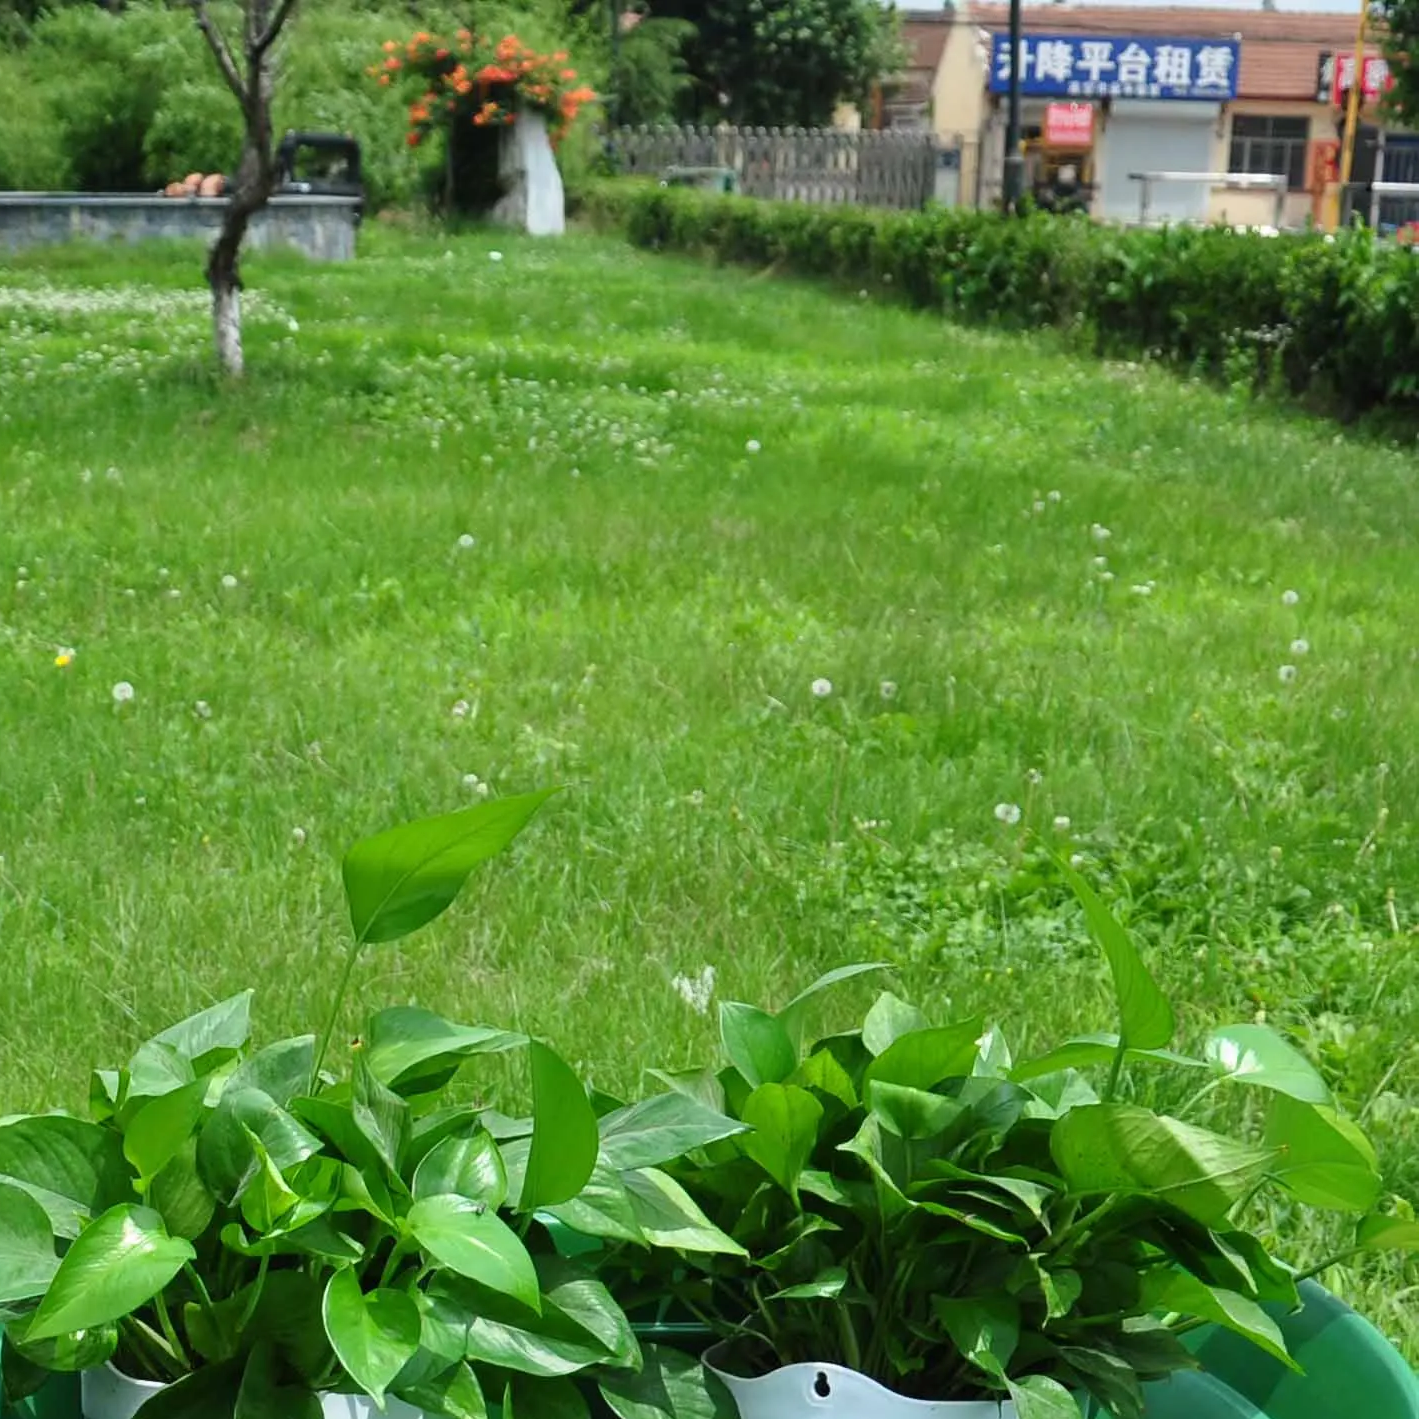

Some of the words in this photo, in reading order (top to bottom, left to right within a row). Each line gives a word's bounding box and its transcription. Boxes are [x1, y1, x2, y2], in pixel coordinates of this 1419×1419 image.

[997, 39, 1234, 88] 升降平台租赁
